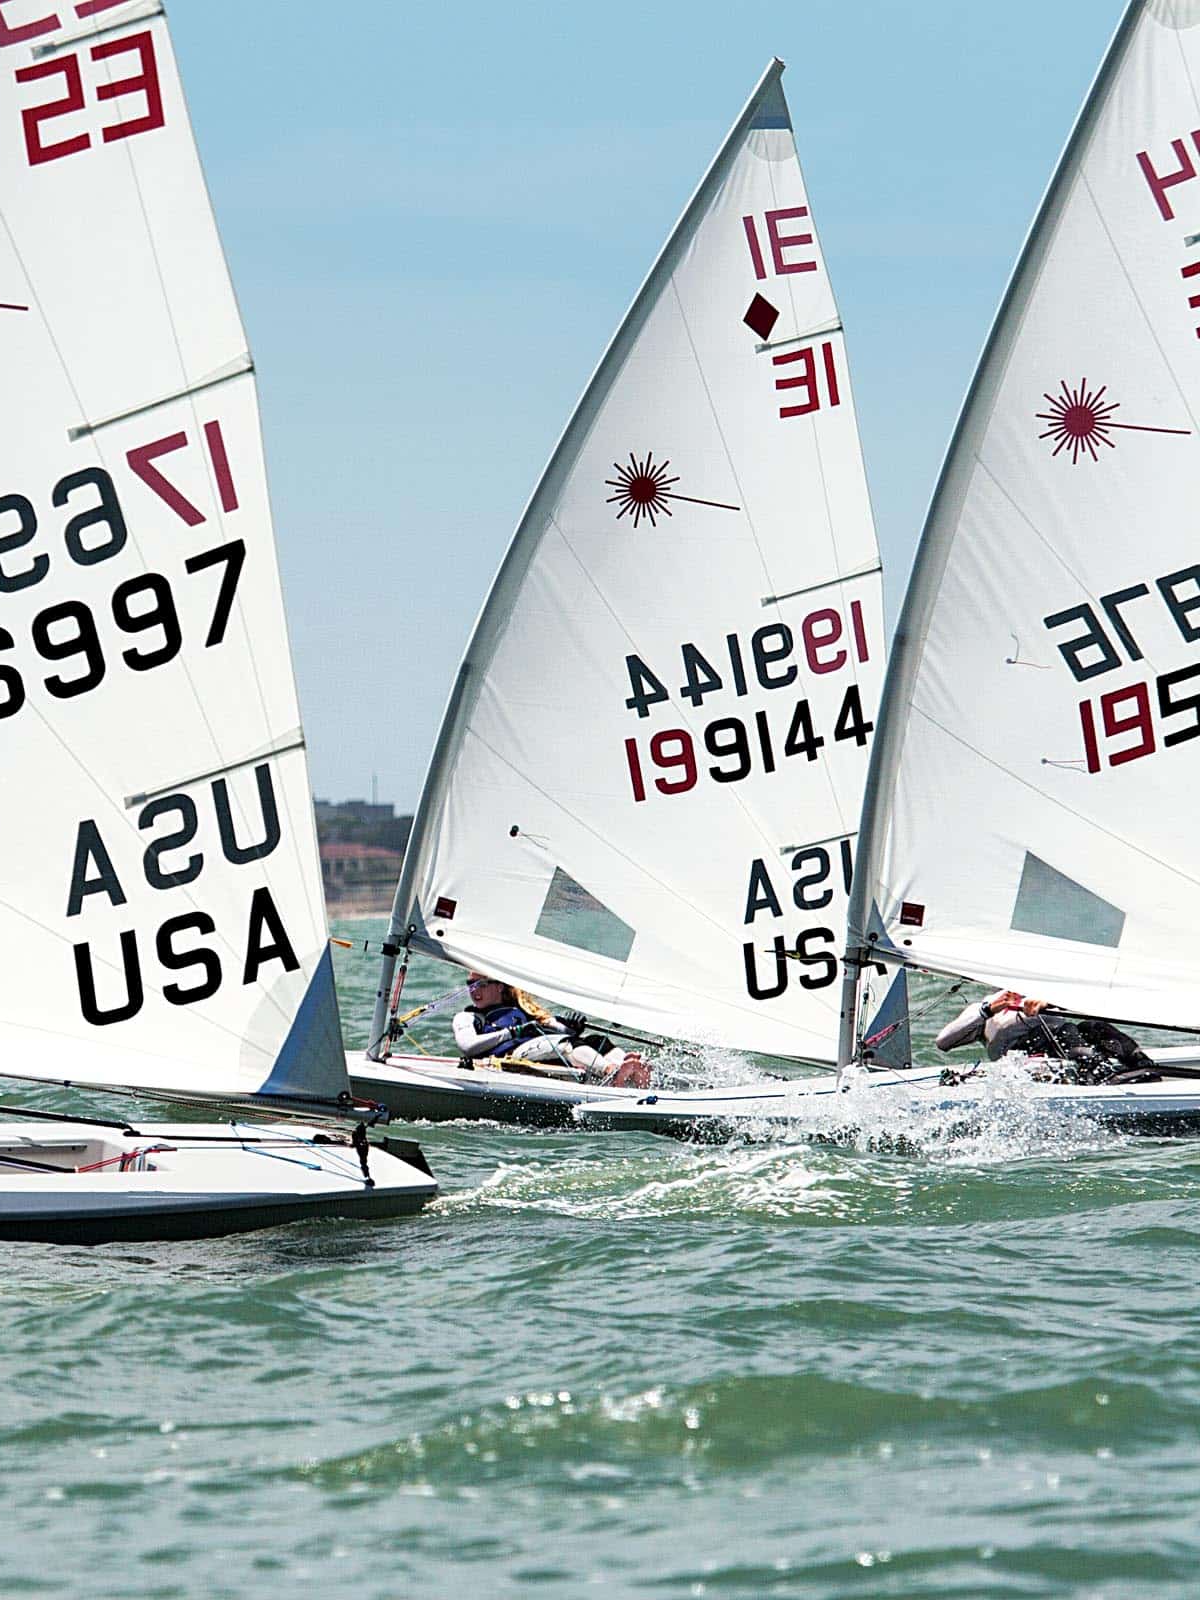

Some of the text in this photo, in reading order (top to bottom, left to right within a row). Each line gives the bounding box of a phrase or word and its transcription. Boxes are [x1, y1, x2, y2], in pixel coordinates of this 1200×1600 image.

[15, 30, 165, 166] 23
[624, 684, 874, 802] 199144
[73, 886, 301, 1027] USA
[742, 926, 888, 1001] US
